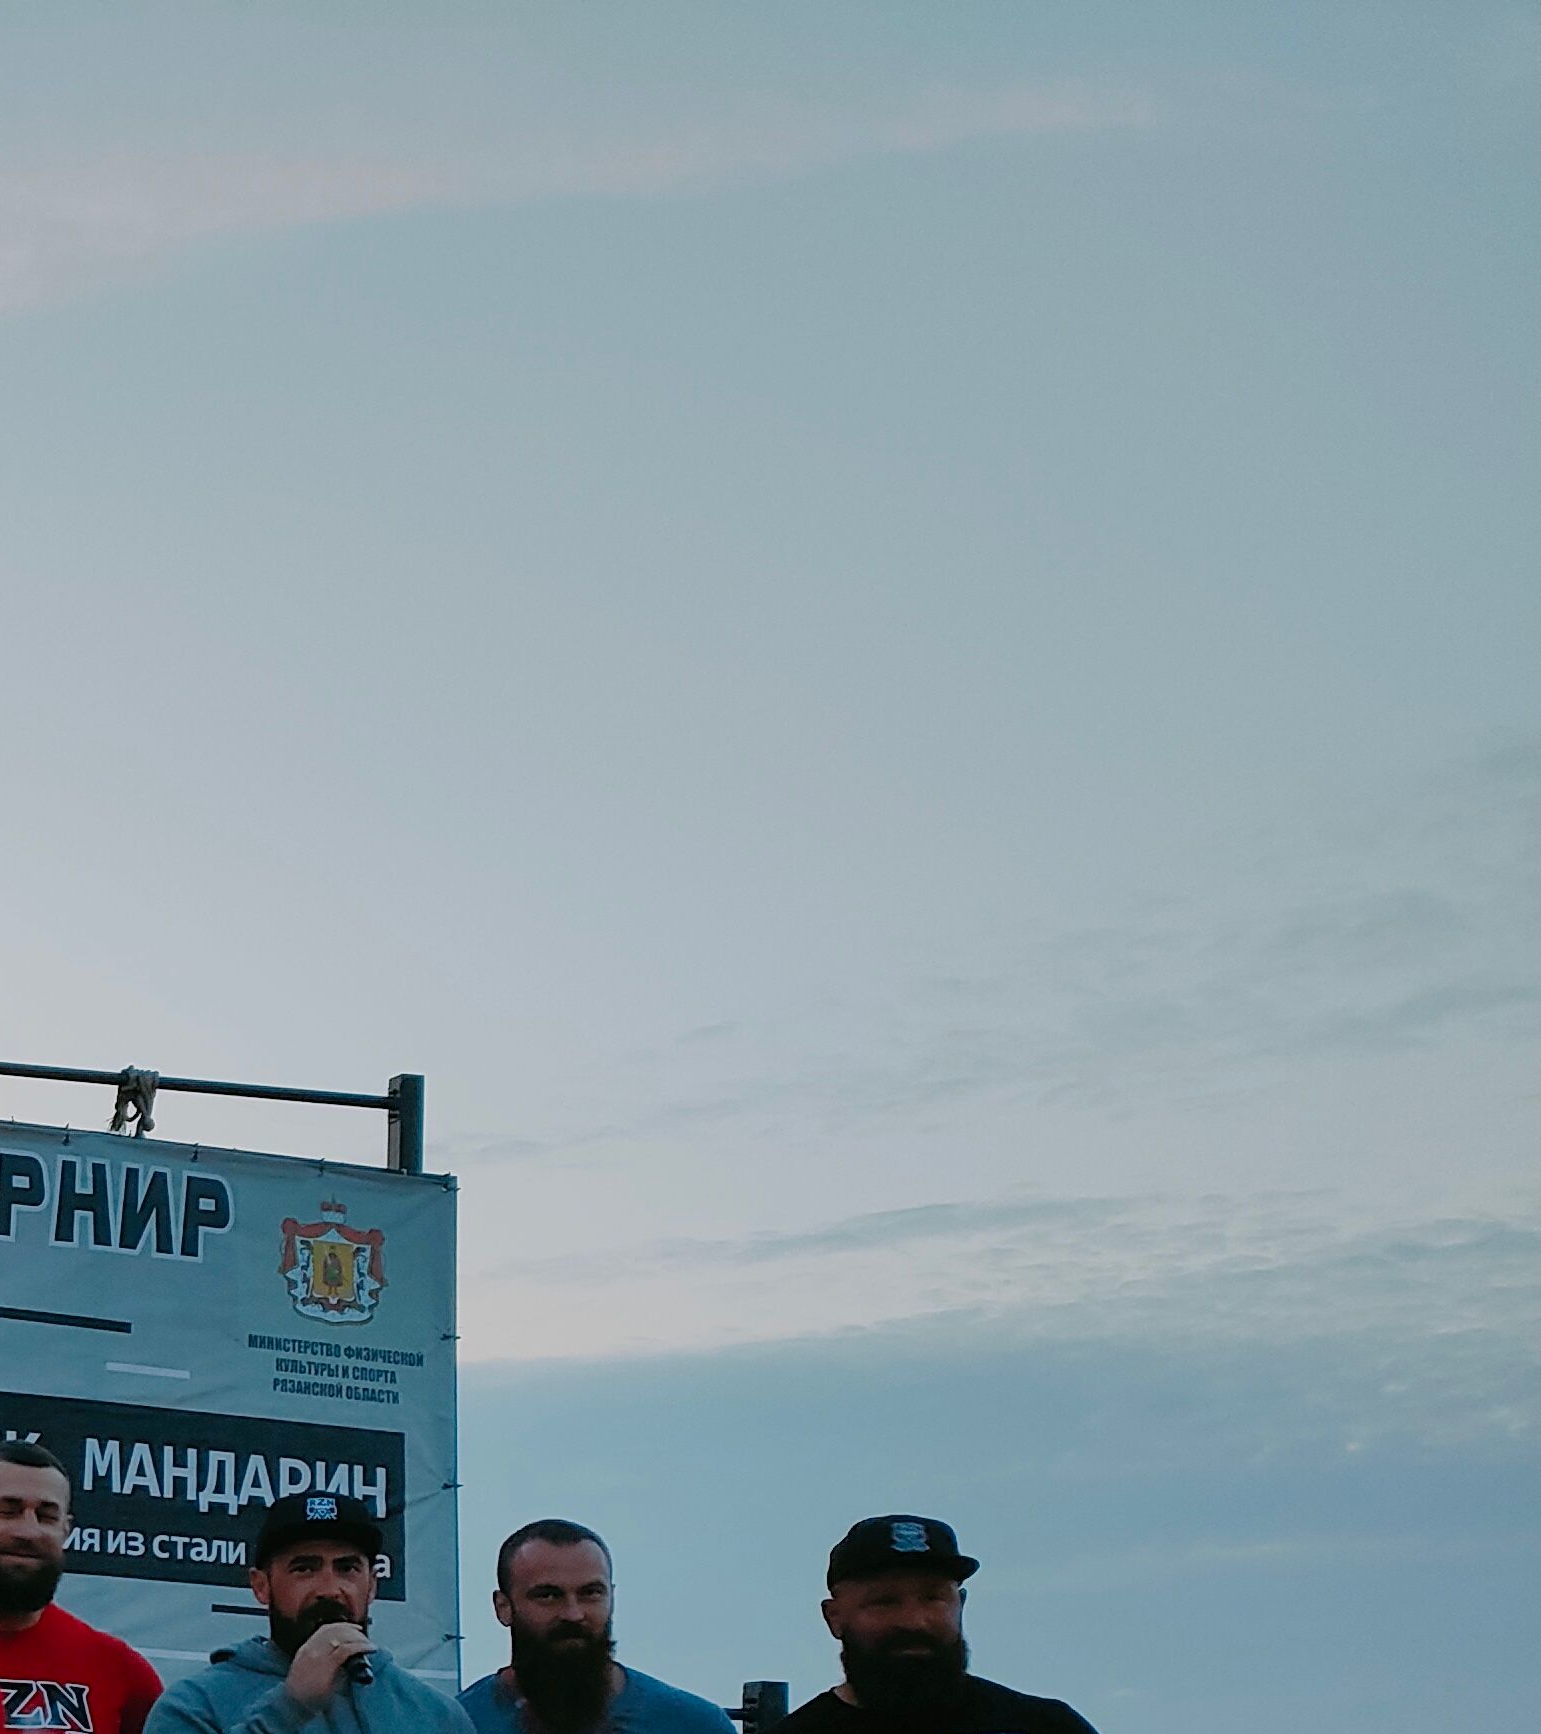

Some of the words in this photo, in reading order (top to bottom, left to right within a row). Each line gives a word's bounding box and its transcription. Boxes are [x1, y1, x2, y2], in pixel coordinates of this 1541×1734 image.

[248, 1333, 341, 1358] МИНИСТЕРСТВО
[344, 1346, 424, 1367] ФИЗИЧЕСКОЙ
[275, 1357, 339, 1378] КУЛЬТУРЫ
[341, 1365, 350, 1379] И
[352, 1366, 397, 1384] СПОРТА
[273, 1377, 343, 1398] РЯЗАНСКОЙ
[345, 1385, 400, 1404] ОБЛАСТИ
[82, 1436, 388, 1520] МАНДАРИН
[107, 1529, 146, 1557] из
[152, 1533, 247, 1566] стали
